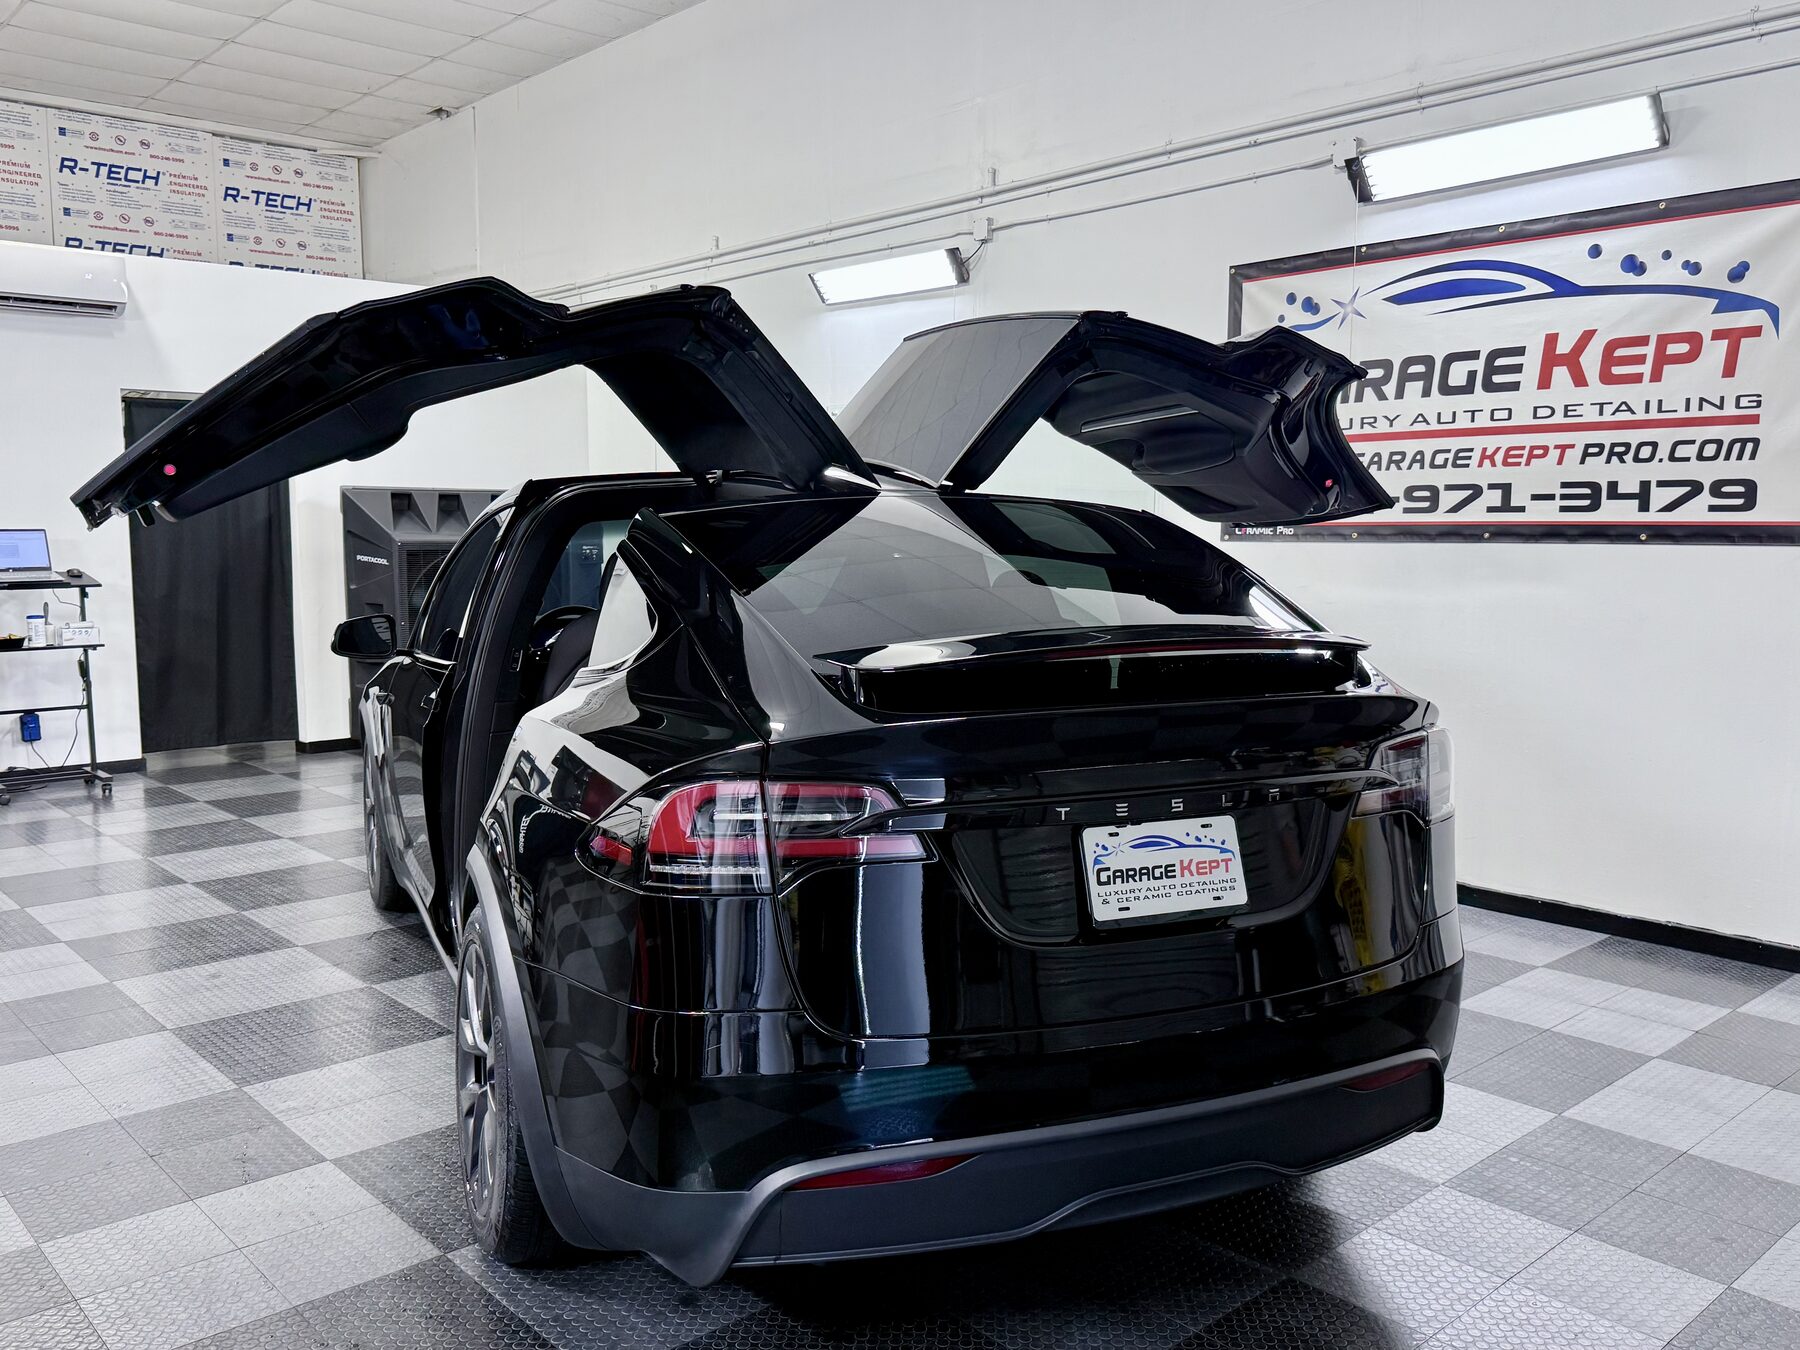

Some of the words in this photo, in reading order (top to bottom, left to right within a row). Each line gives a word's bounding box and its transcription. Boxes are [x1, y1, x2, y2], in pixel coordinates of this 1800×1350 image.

[0, 177, 39, 187] NSULATION
[58, 156, 162, 187] R-TECH
[168, 172, 199, 182] PREMIUM
[169, 189, 206, 198] INSULATION
[223, 186, 313, 213] R-TECH
[1340, 345, 1527, 405] RAGE
[1536, 325, 1763, 391] KEPT
[1339, 414, 1402, 431] URY
[1409, 407, 1513, 427] AUTO
[1531, 393, 1763, 420] DETAILING
[356, 554, 389, 565] PORTACOOL
[1096, 863, 1177, 887] GARAGE
[1179, 857, 1233, 878] KEPT
[1097, 887, 1143, 898] LUXURY
[1145, 883, 1177, 893] AUTO
[1180, 877, 1237, 889] DETAILING
[1116, 891, 1172, 904] CERAMIC
[1176, 885, 1236, 897] COATINGS
